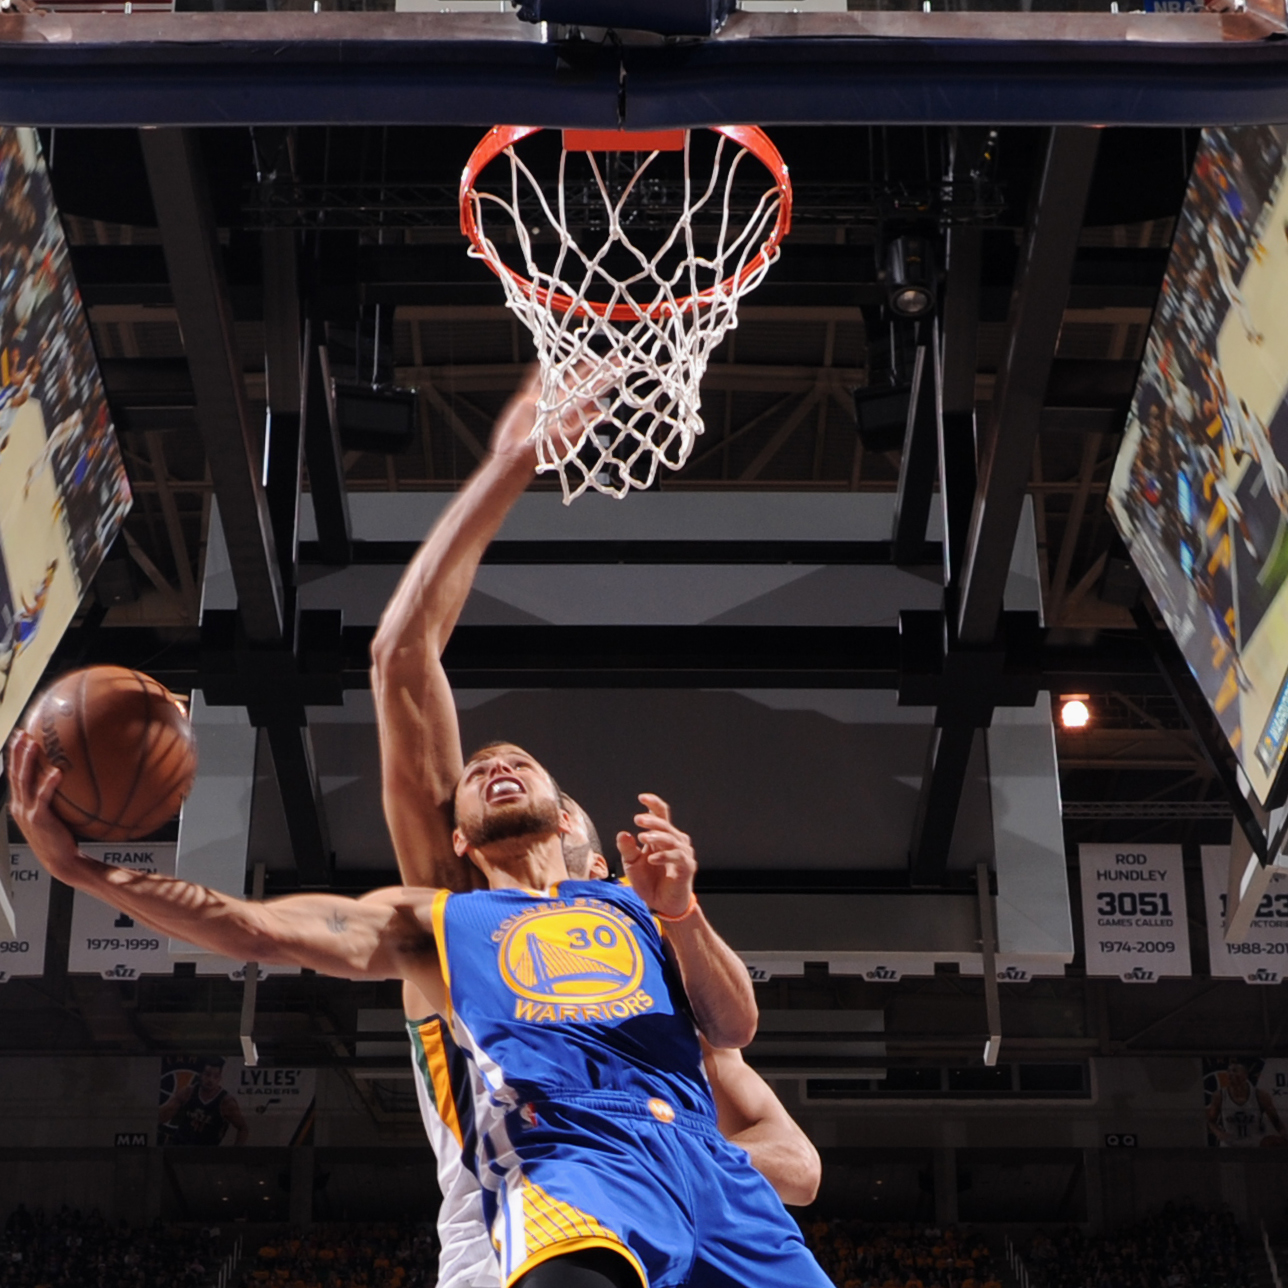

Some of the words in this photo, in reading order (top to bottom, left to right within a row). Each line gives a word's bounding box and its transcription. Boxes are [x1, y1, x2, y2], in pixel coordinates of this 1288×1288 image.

[103, 852, 154, 864] FRANK
[1115, 853, 1147, 865] ROD
[1096, 869, 1168, 882] HUNDLEY
[1096, 892, 1173, 916] 3051
[490, 901, 566, 943] GOLDEN
[573, 898, 637, 927] STATE
[1097, 918, 1133, 927] GAMES
[1135, 918, 1174, 928] CALLED
[566, 924, 618, 951] 30
[86, 938, 160, 951] 1979-1999
[1099, 941, 1176, 953] 1974-2009
[514, 989, 654, 1023] WARRIORS
[240, 1070, 301, 1086] LYLES'
[116, 1134, 146, 1146] MM
